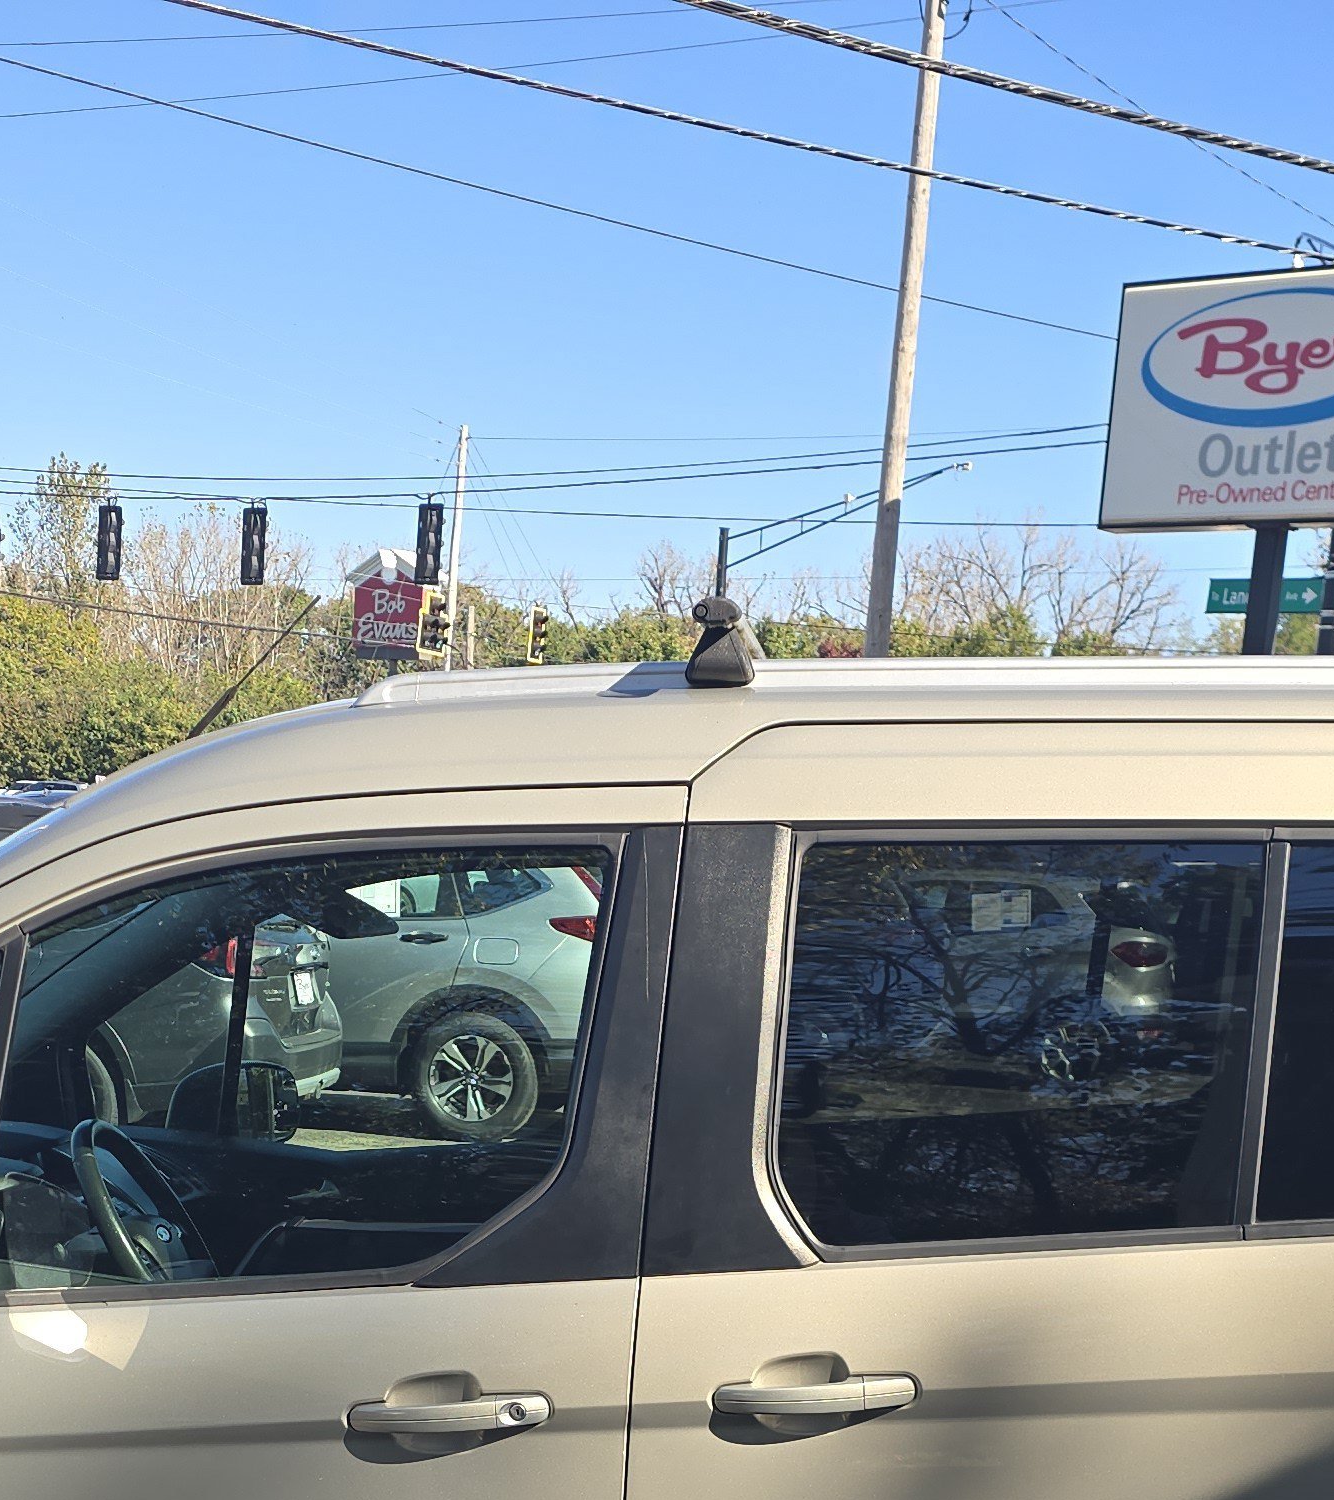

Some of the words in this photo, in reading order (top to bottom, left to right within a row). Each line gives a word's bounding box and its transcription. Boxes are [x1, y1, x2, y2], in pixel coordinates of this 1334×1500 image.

[1177, 480, 1288, 505] Pre-Owned
[371, 588, 405, 615] Bob
[356, 612, 418, 640] Evans
